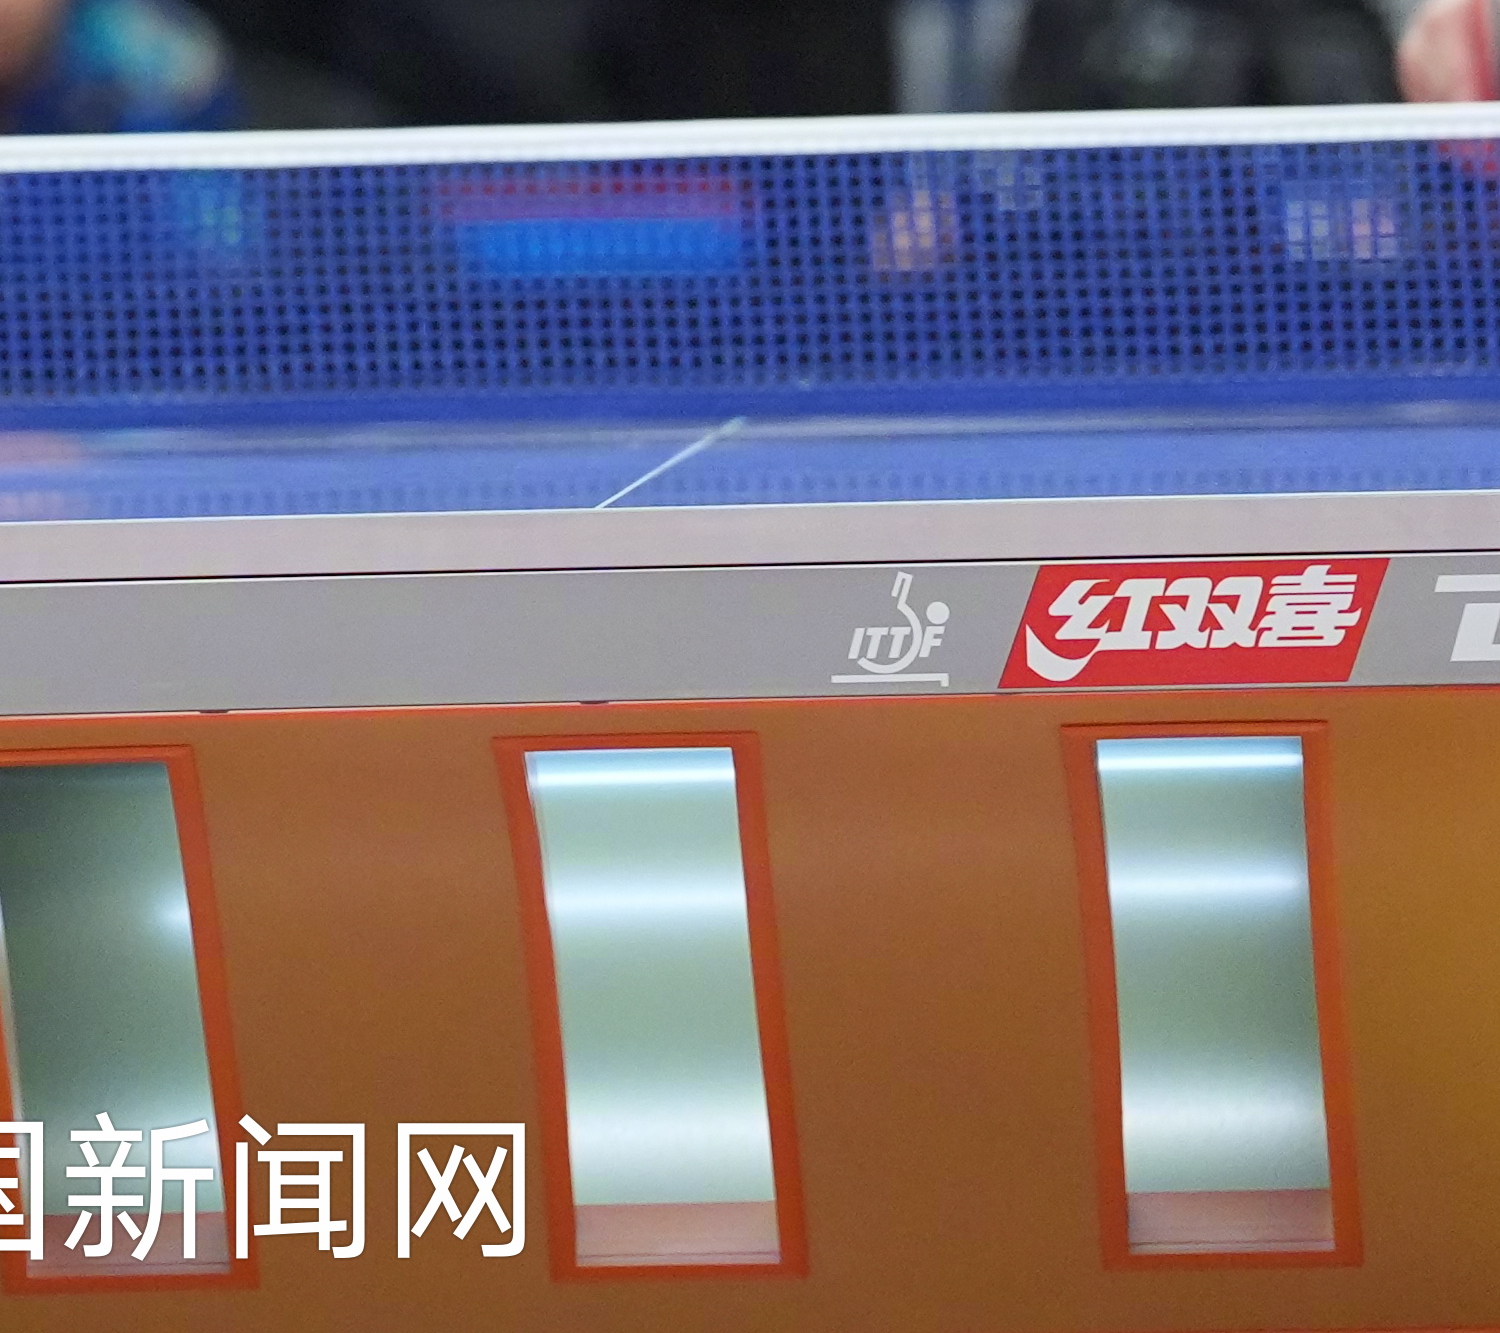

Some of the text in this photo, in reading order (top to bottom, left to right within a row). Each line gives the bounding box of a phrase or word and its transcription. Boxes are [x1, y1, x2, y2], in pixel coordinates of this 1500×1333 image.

[848, 626, 944, 660] ITTF
[1025, 564, 1362, 682] 红双喜
